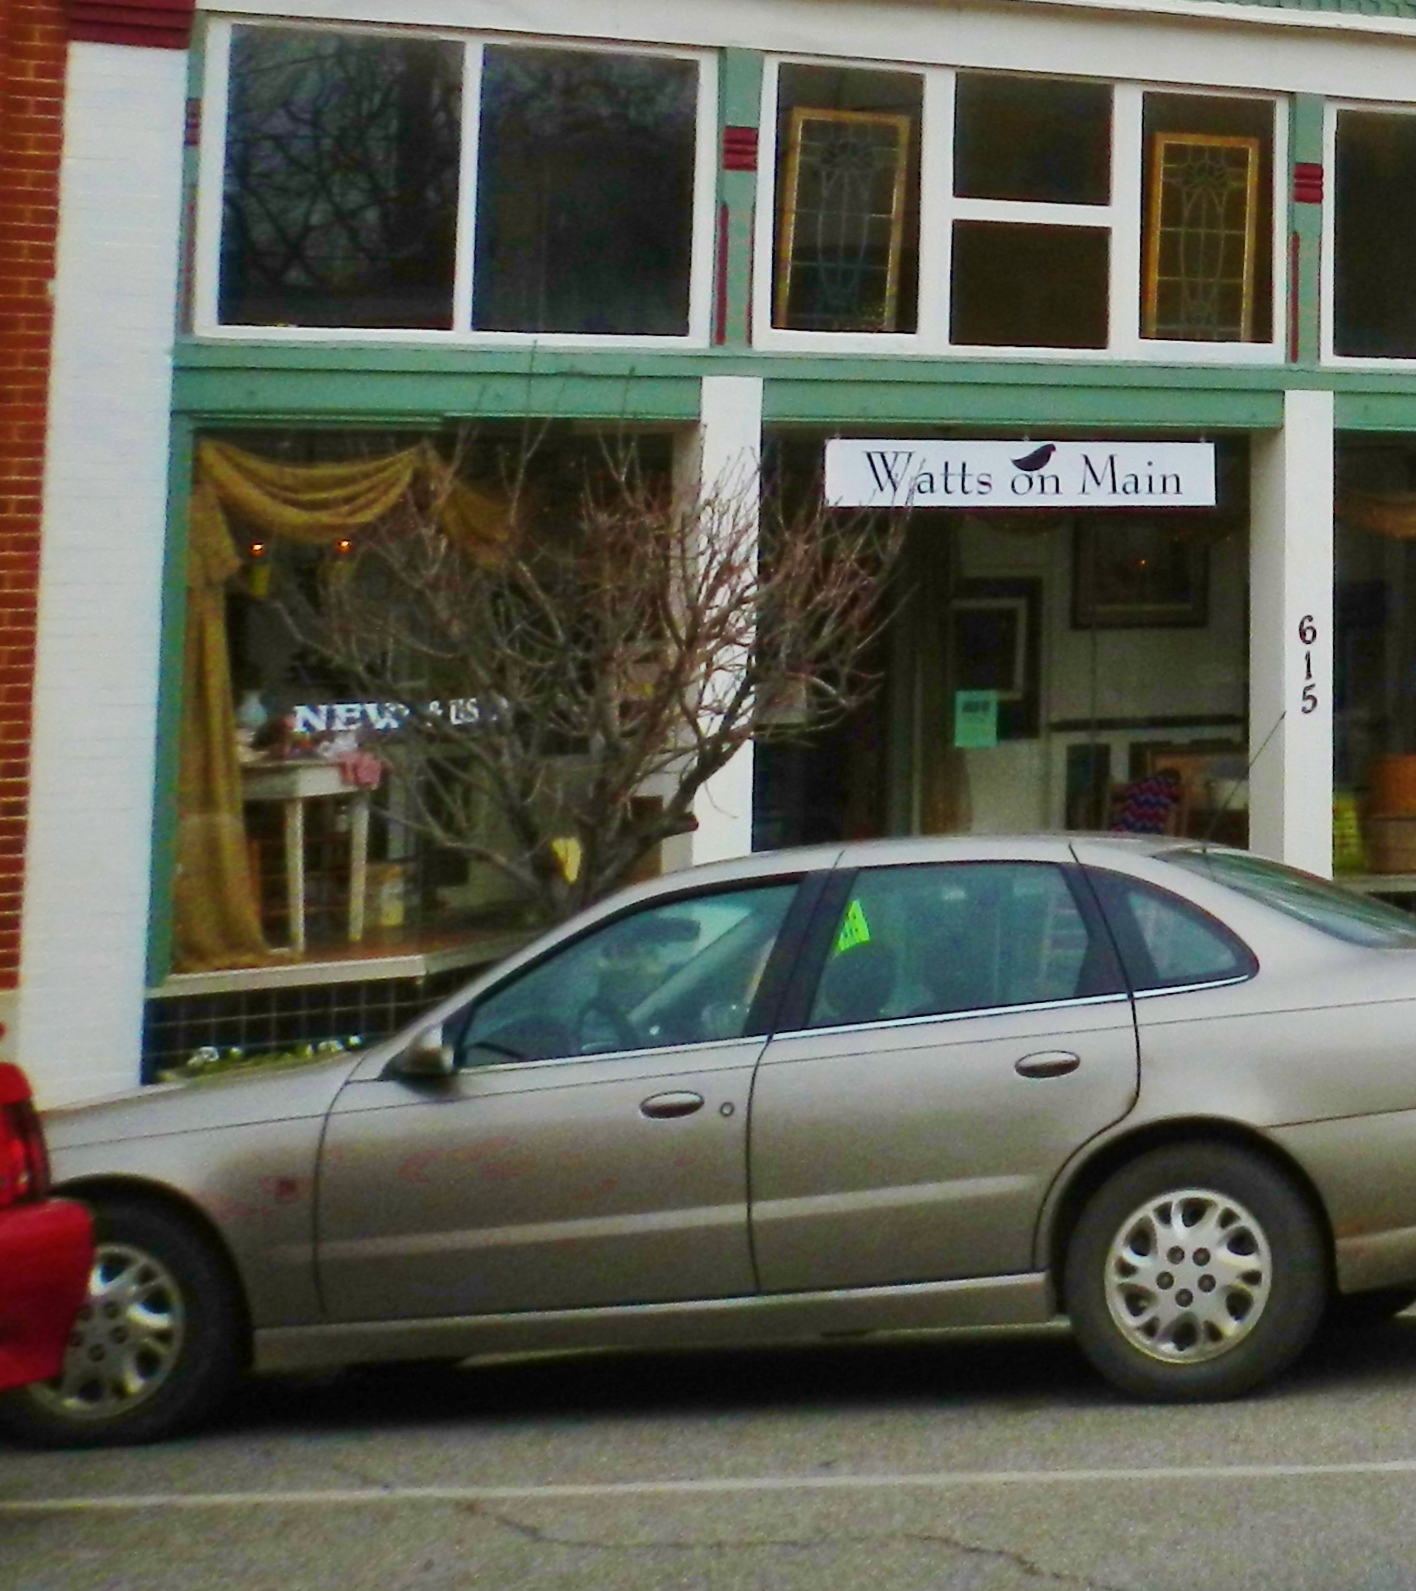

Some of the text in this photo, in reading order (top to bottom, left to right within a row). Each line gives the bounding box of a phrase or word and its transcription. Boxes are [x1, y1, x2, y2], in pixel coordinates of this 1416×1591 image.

[863, 450, 1184, 496] Watts on Main
